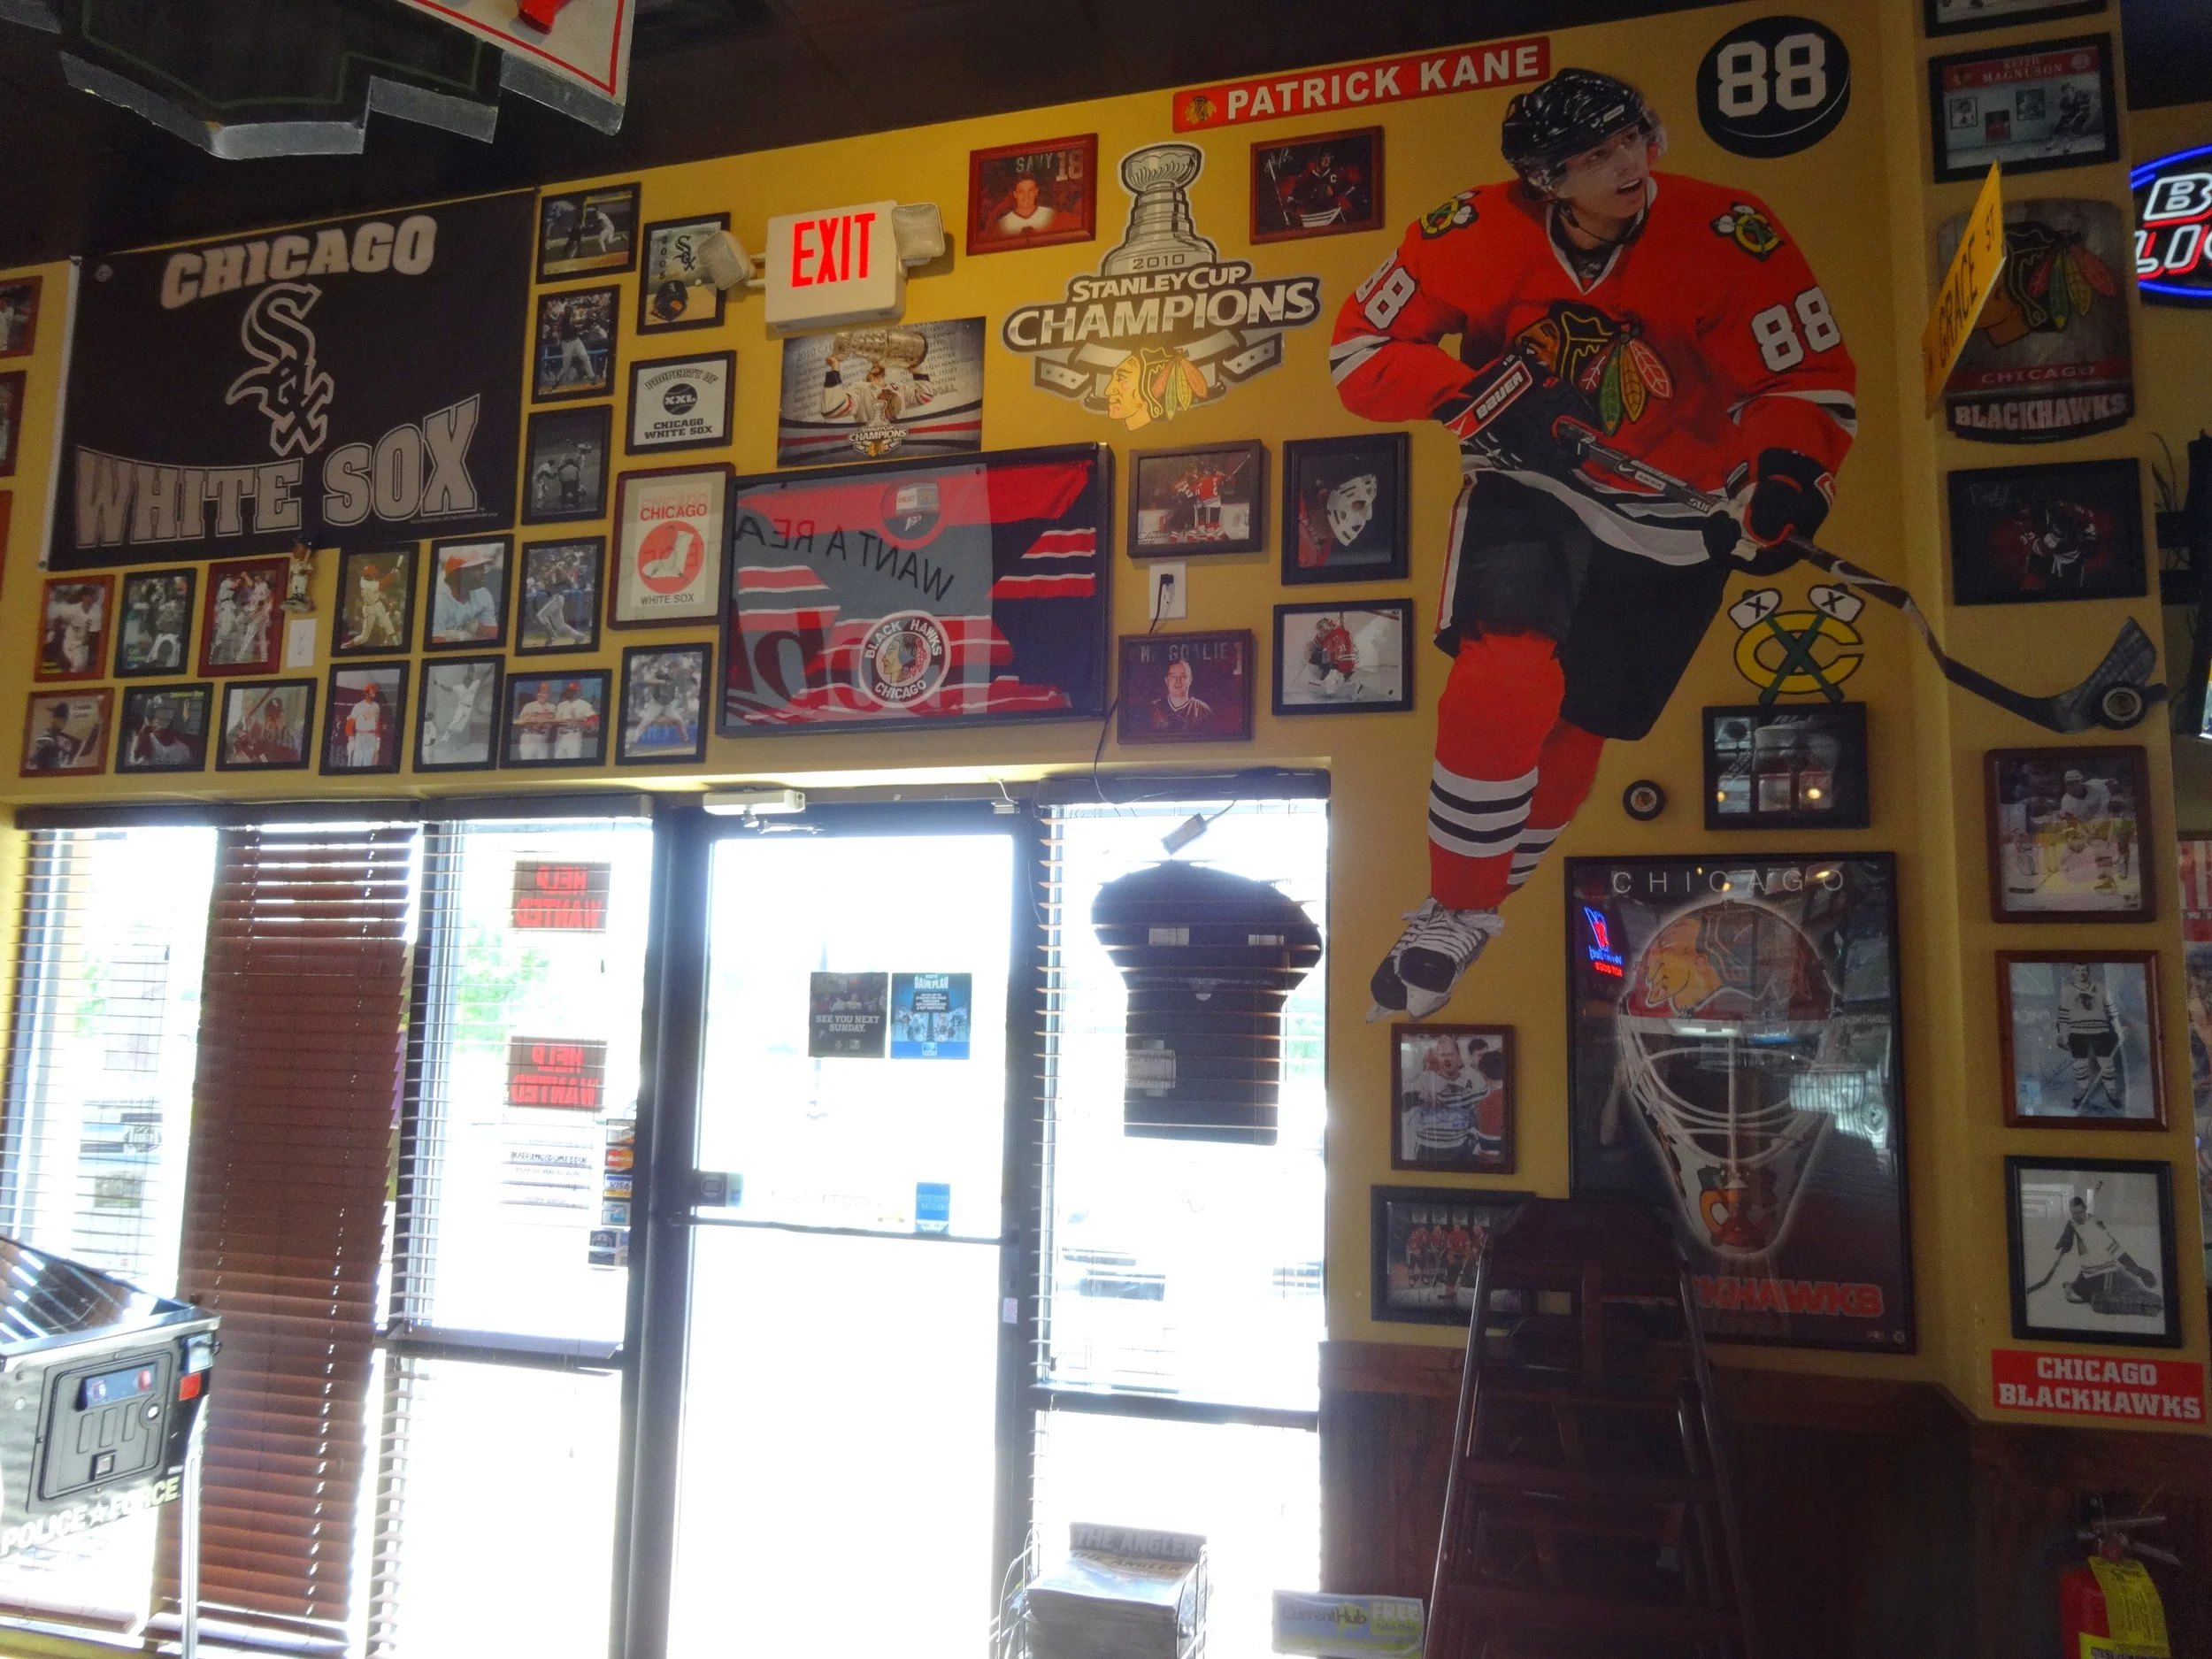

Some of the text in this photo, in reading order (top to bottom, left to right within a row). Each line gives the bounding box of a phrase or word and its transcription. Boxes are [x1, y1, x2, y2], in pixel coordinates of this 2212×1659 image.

[1226, 44, 1541, 121] PATRICK KANE
[1717, 32, 1827, 119] 88
[160, 213, 438, 310] CHICAGO
[790, 211, 877, 289] EXIT
[1132, 253, 1186, 271] 2010
[1071, 265, 1248, 302] STANLEY CUP
[1005, 280, 1317, 346] CHAMPIONS
[1751, 285, 1841, 373] 88
[644, 368, 718, 390] PROPERTY OF
[1981, 365, 2096, 384] CHICAGO
[664, 395, 697, 405] XXL
[1955, 392, 2128, 430] BLACKHAWKS
[644, 425, 713, 440] WHITE SOX
[653, 418, 704, 430] CHICAGO
[849, 429, 907, 442] CHAMPIONS
[76, 393, 481, 549] WHITE SOX
[640, 503, 708, 521] CHICAGO
[640, 593, 695, 606] WHITE SOX
[864, 618, 943, 659] BLACK HAWKS
[874, 679, 927, 699] CHICAGO
[1612, 868, 1845, 894] CHICAGO
[835, 1015, 855, 1024] YOU
[1692, 1275, 1884, 1317] KHAWKS
[2037, 1356, 2158, 1387] CHICAGO
[1998, 1382, 2202, 1420] BLACKHAWKS
[1, 1477, 181, 1557] POLICE FORCE
[1077, 1528, 1198, 1558] THE ANGLER
[1371, 1601, 1419, 1621] FREE
